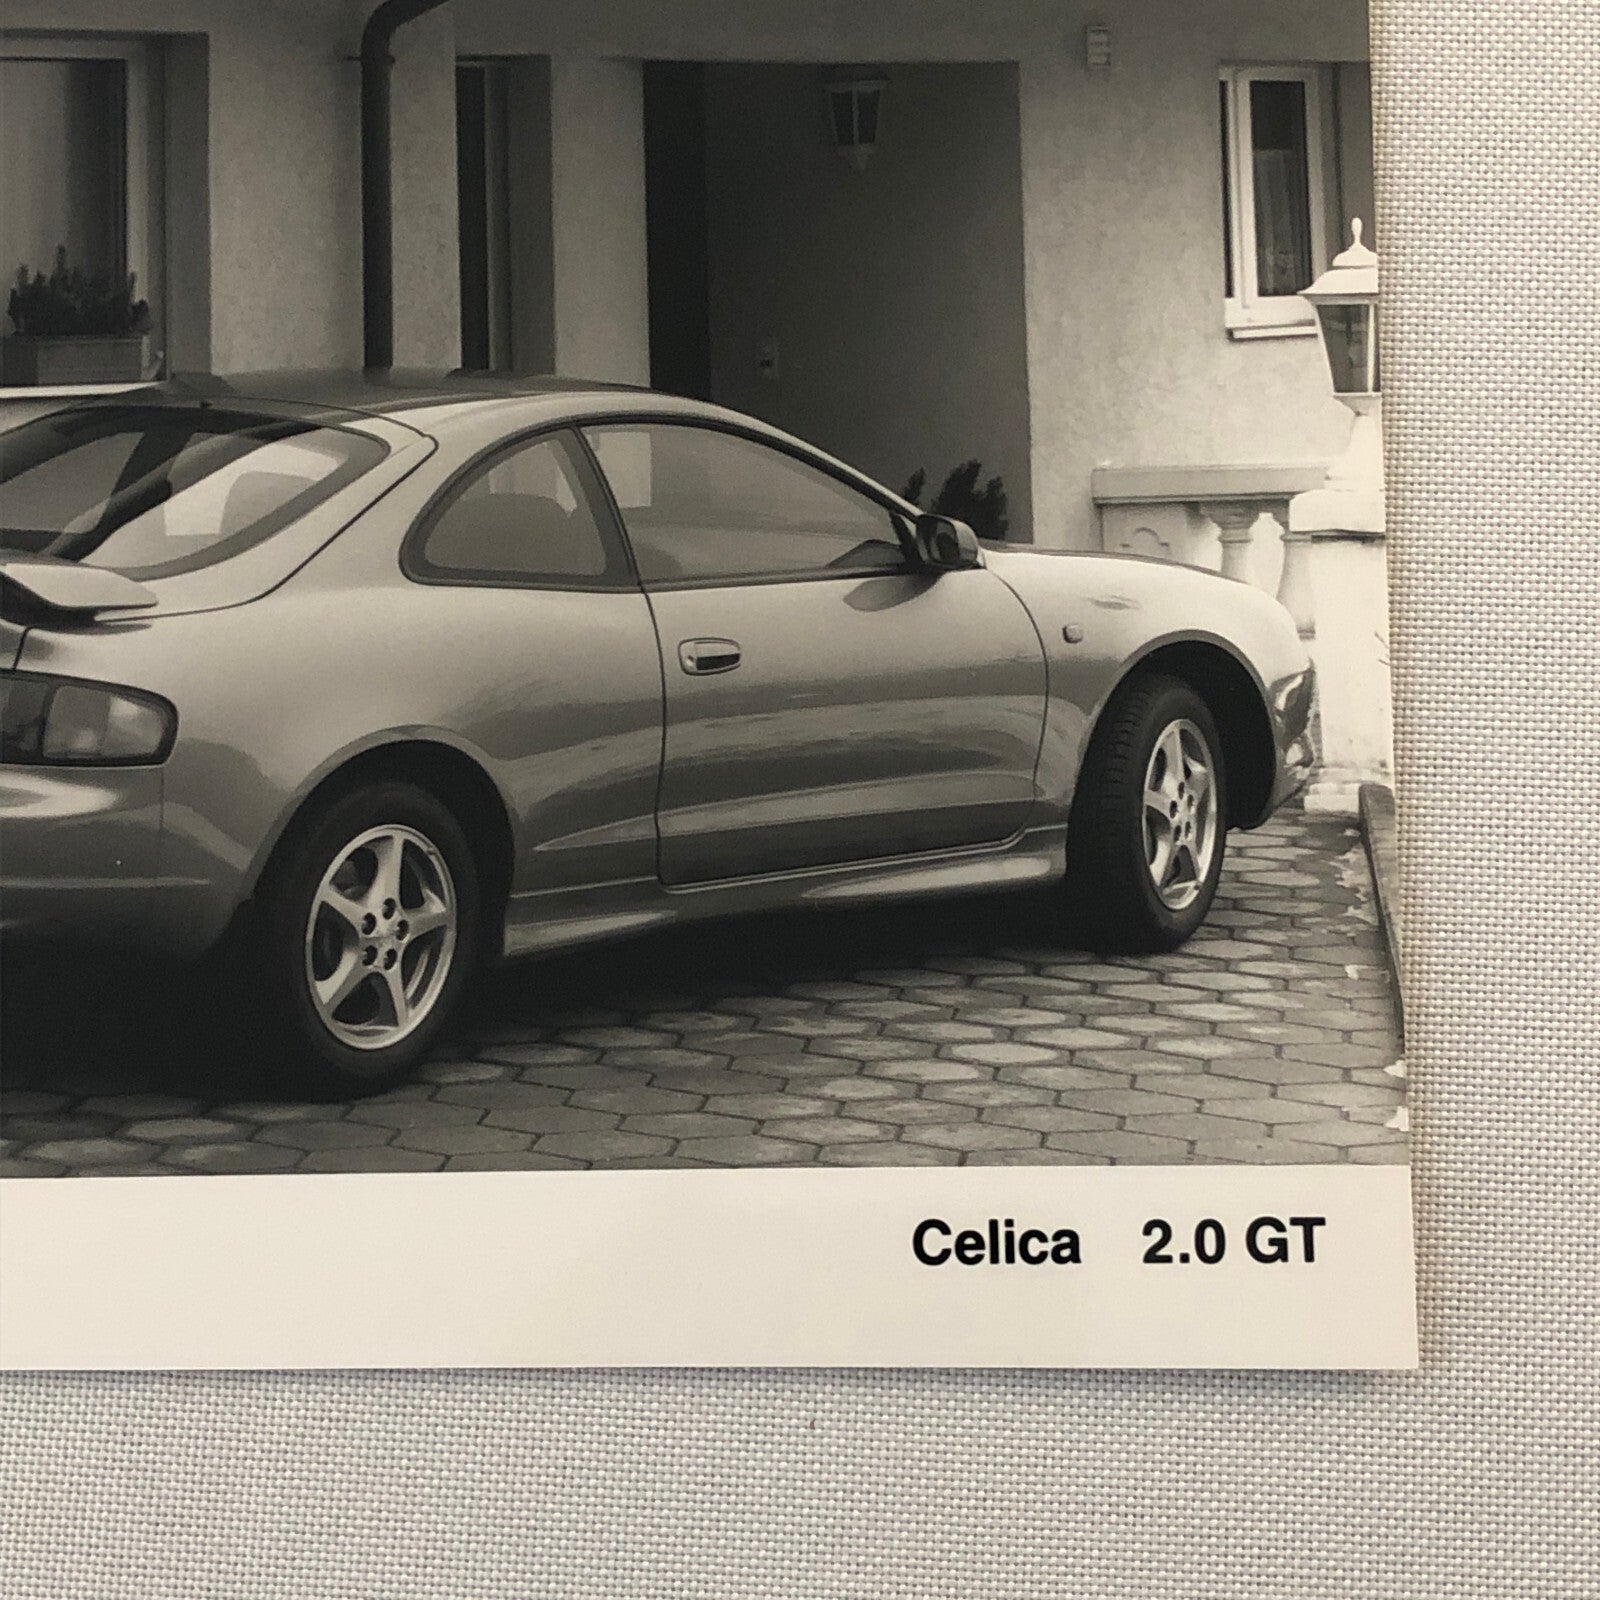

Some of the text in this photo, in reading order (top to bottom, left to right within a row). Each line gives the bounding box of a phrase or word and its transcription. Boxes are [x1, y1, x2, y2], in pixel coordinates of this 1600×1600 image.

[912, 1216, 1326, 1266] Celica 2.0 GT
